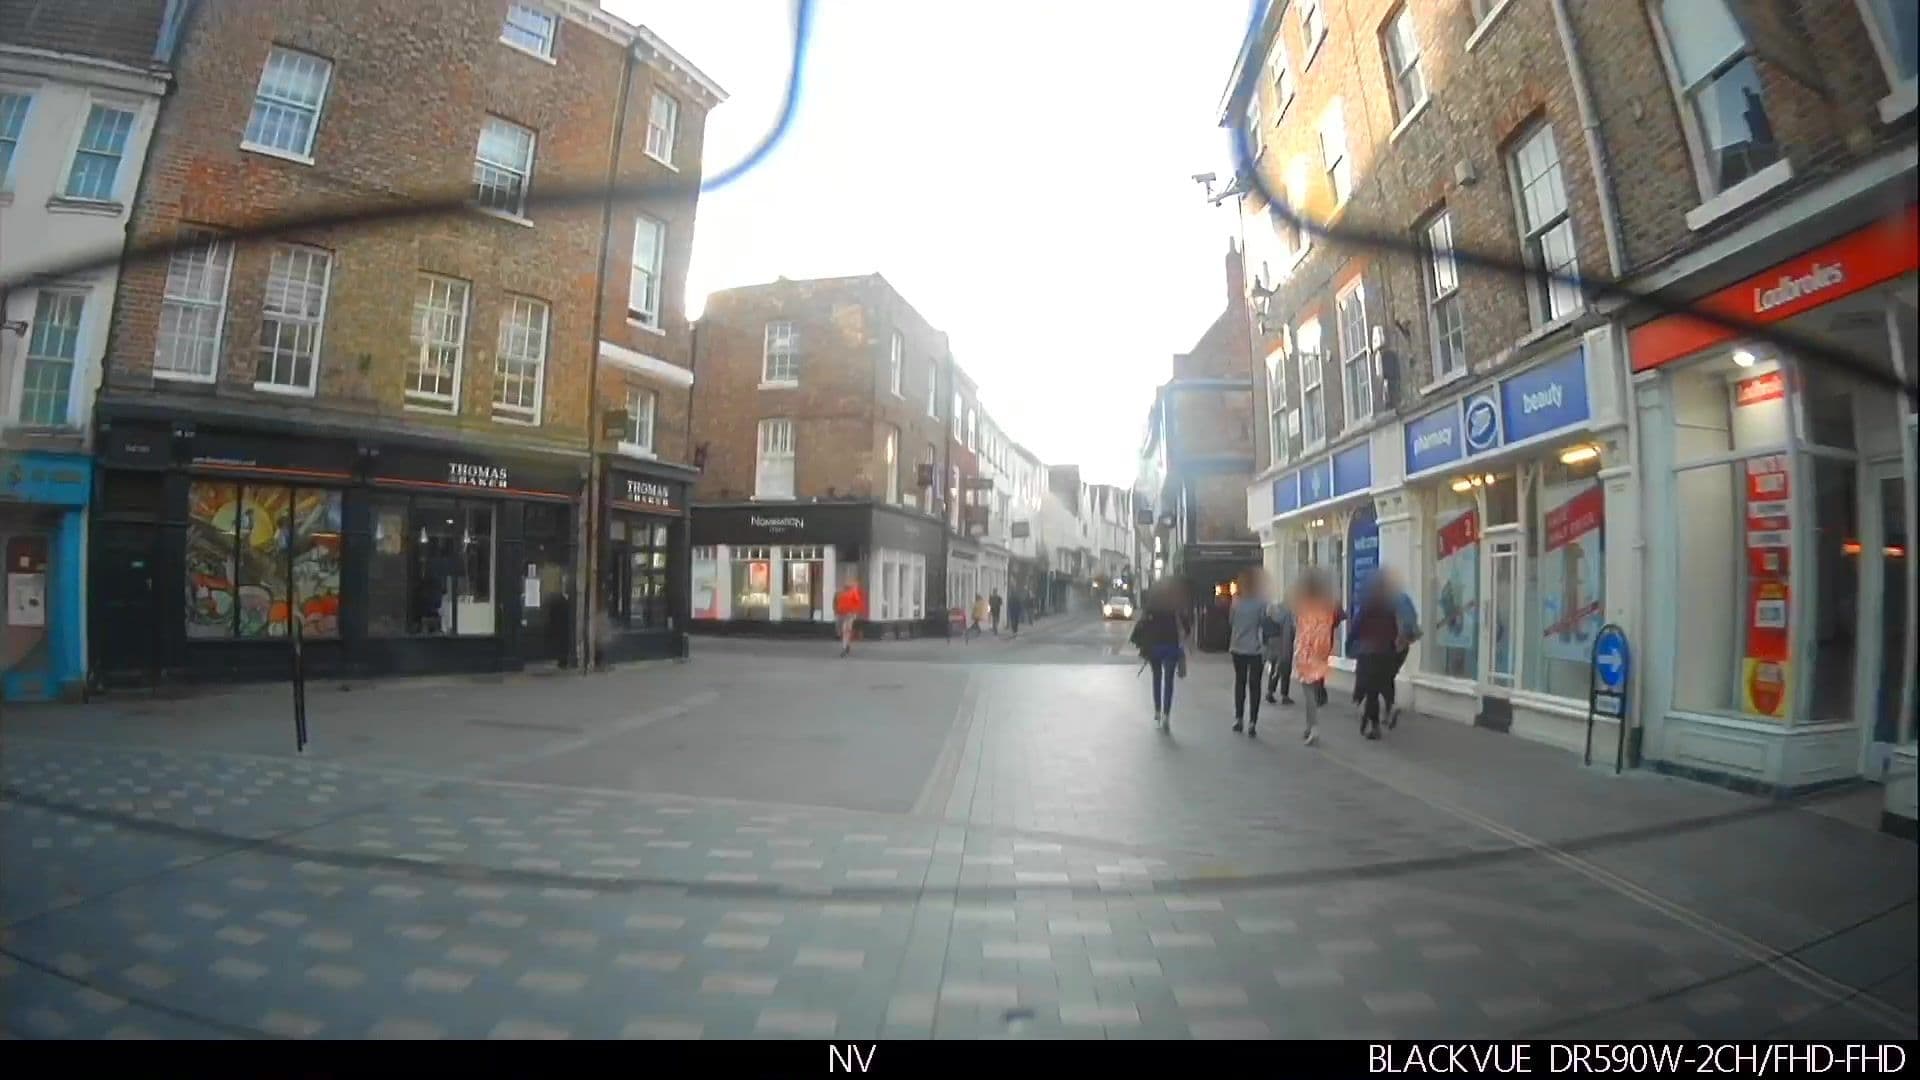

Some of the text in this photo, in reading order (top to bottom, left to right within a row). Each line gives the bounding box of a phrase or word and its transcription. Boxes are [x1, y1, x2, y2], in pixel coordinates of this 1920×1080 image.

[1753, 261, 1843, 313] Ladbrokes
[1522, 382, 1563, 415] beauty
[1413, 426, 1453, 457] pharmacy
[448, 462, 508, 480] THOMAS
[626, 479, 669, 498] THOMAS
